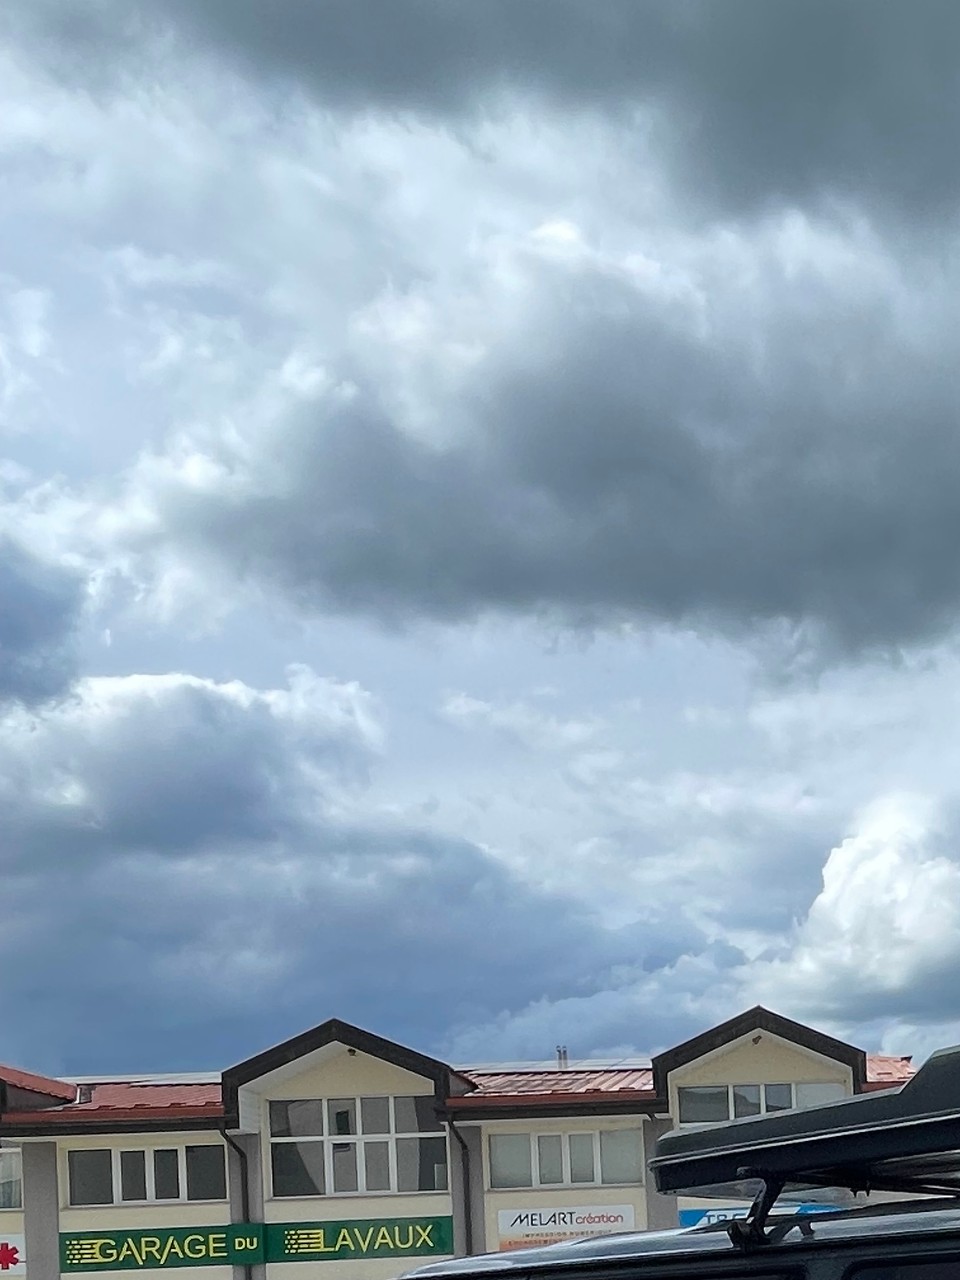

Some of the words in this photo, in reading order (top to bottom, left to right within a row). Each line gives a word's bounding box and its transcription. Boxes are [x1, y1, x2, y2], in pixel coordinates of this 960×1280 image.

[93, 1233, 228, 1265] GARAGE
[234, 1237, 258, 1250] DU
[318, 1224, 434, 1253] LAVAUX
